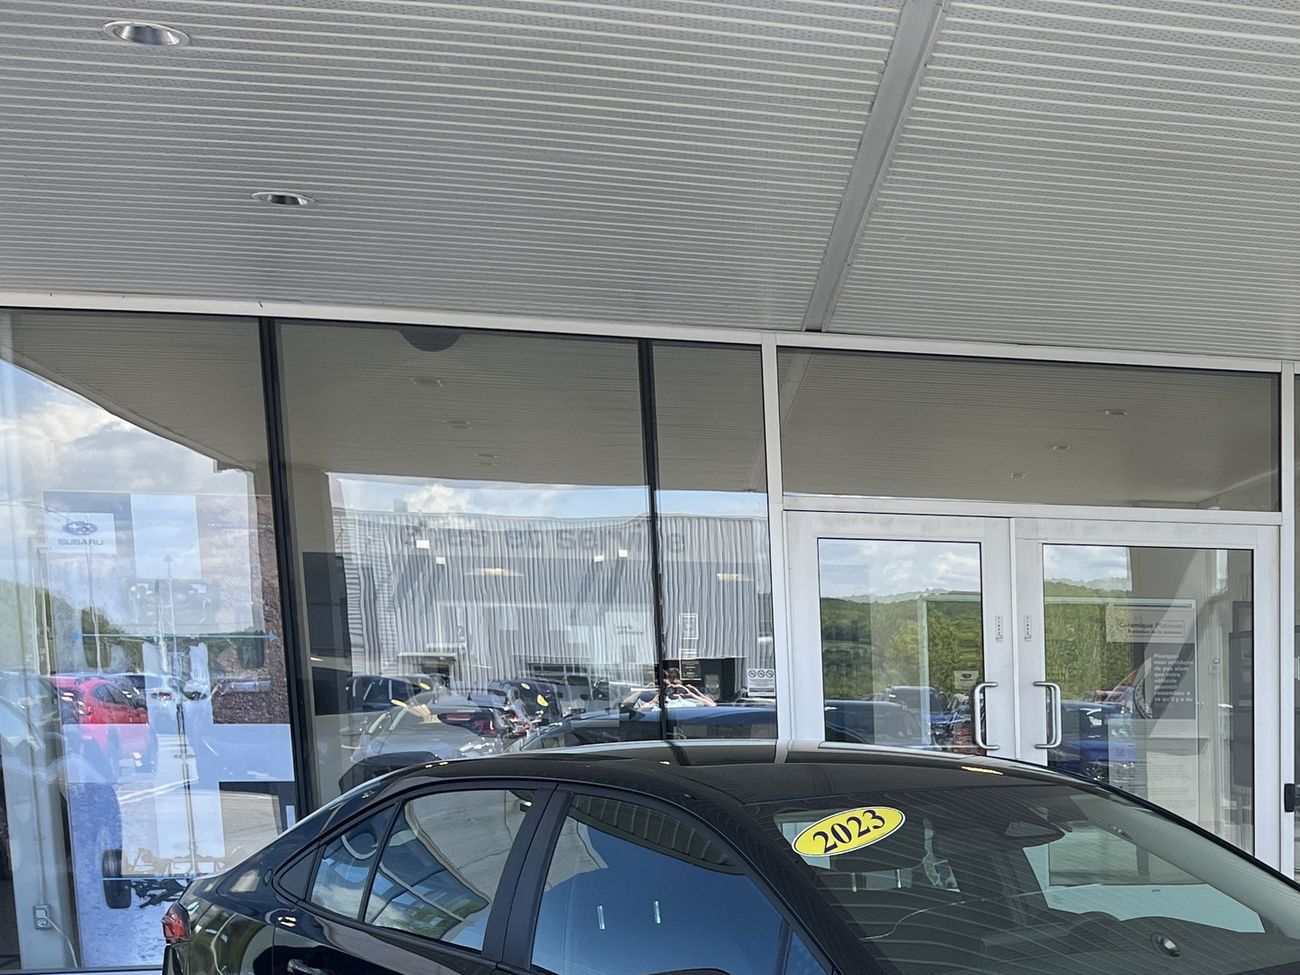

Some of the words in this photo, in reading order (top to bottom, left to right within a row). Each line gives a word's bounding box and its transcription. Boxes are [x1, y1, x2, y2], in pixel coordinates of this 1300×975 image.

[58, 538, 104, 546] SUBARU
[556, 527, 686, 554] servie
[812, 809, 886, 853] 2023
